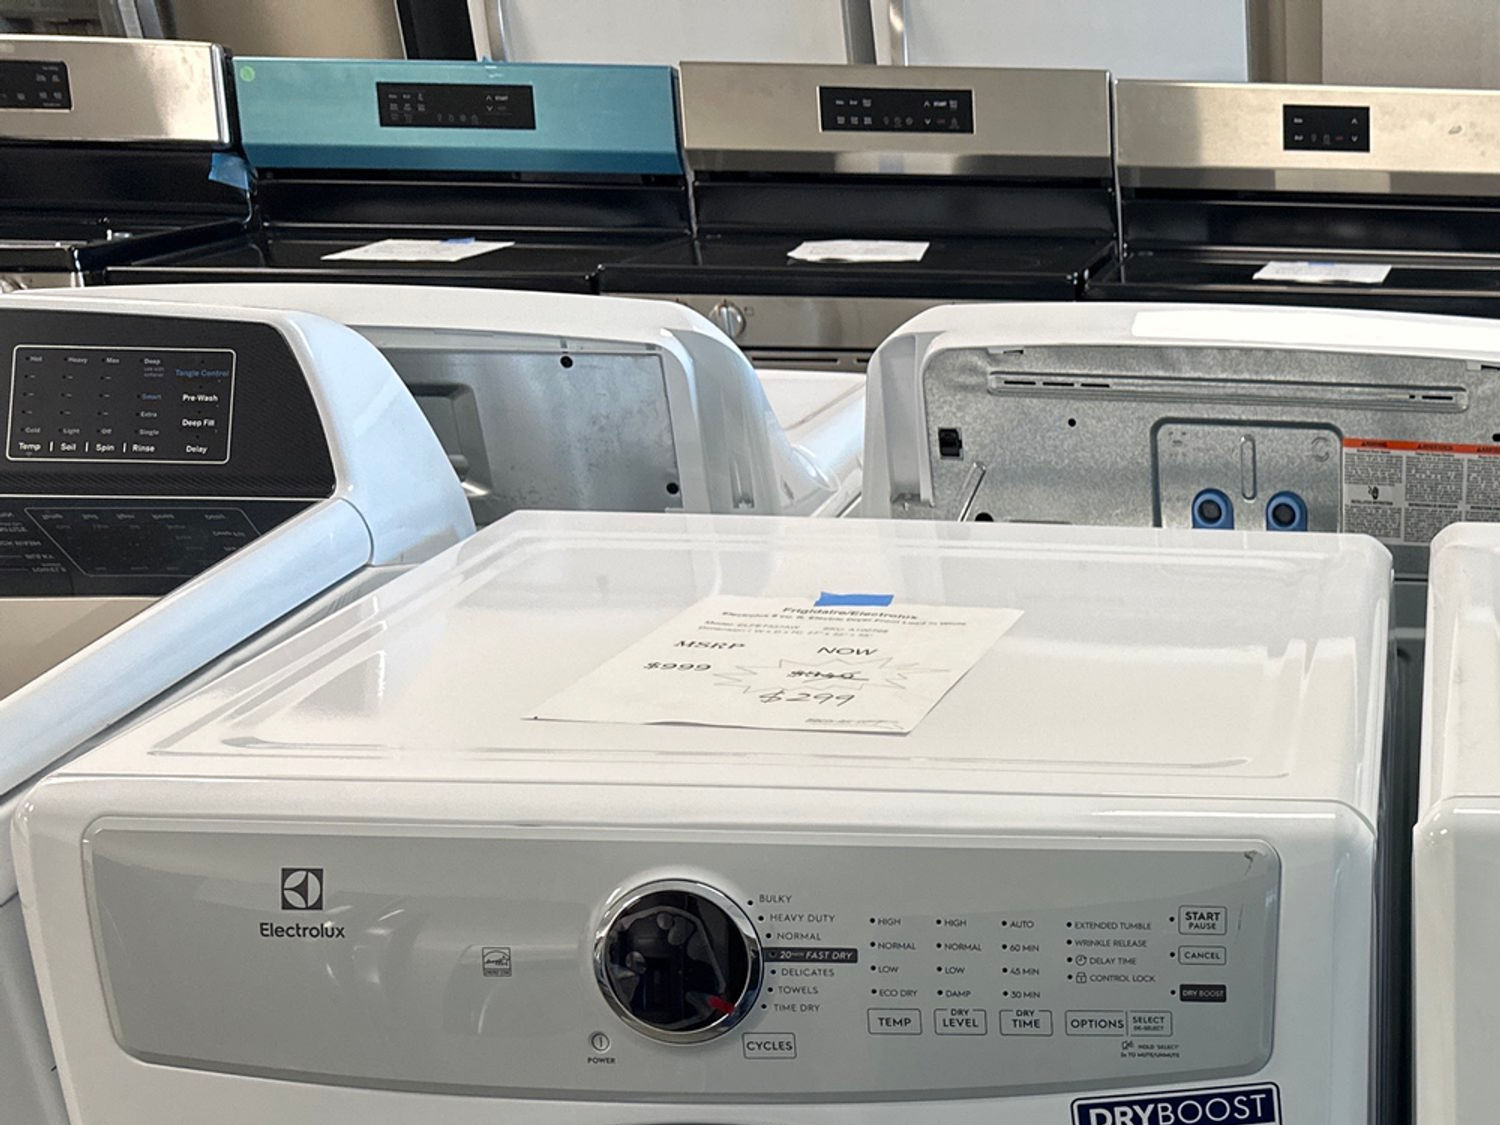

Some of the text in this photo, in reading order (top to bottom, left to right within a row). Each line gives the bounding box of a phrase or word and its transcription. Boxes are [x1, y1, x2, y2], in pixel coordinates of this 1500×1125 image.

[144, 358, 161, 366] Deep
[175, 369, 230, 378] Tangle Control
[182, 419, 215, 428] Deep Fill
[139, 428, 159, 436] Single
[19, 443, 41, 452] Temp
[61, 443, 77, 451] Soil
[96, 444, 115, 453] Spin
[132, 444, 155, 452] Rinse
[186, 445, 208, 454] Delay
[674, 640, 745, 649] MSRP
[817, 646, 878, 656] NOW
[643, 661, 711, 671] $999
[759, 689, 855, 706] $299
[759, 894, 793, 904] BULKY
[770, 913, 835, 923] HEAVY DUTY
[1185, 911, 1220, 921] START
[878, 918, 901, 926] HIGH
[944, 919, 967, 927] HIGH
[1075, 922, 1152, 930] EXTENDED TUMBLE
[1188, 922, 1217, 930] PAUSE
[259, 922, 345, 939] Electrolux
[777, 932, 822, 941] NORMAL
[878, 942, 916, 950] NORMAL
[945, 943, 982, 951] NORMAL
[1075, 939, 1111, 947] WRINKLE
[1009, 944, 1039, 952] 60 MIN
[805, 951, 829, 960] FAST
[831, 951, 853, 960] DRY
[1184, 952, 1221, 960] CANCEL
[1089, 957, 1136, 965] DELAY TIME
[782, 968, 835, 977] DELICATES
[1132, 975, 1156, 983] LOCK
[778, 986, 818, 995] TOWELS
[1010, 991, 1040, 999] 30 MIN
[774, 1003, 820, 1013] TIME DRY
[878, 1017, 912, 1027] TEMP
[943, 1018, 979, 1028] LEVEL
[1012, 1019, 1040, 1028] TIME
[1070, 1019, 1124, 1029] OPTIONS
[1132, 1016, 1165, 1024] SELECT
[746, 1042, 793, 1051] CYCLES
[588, 1057, 615, 1065] POWER
